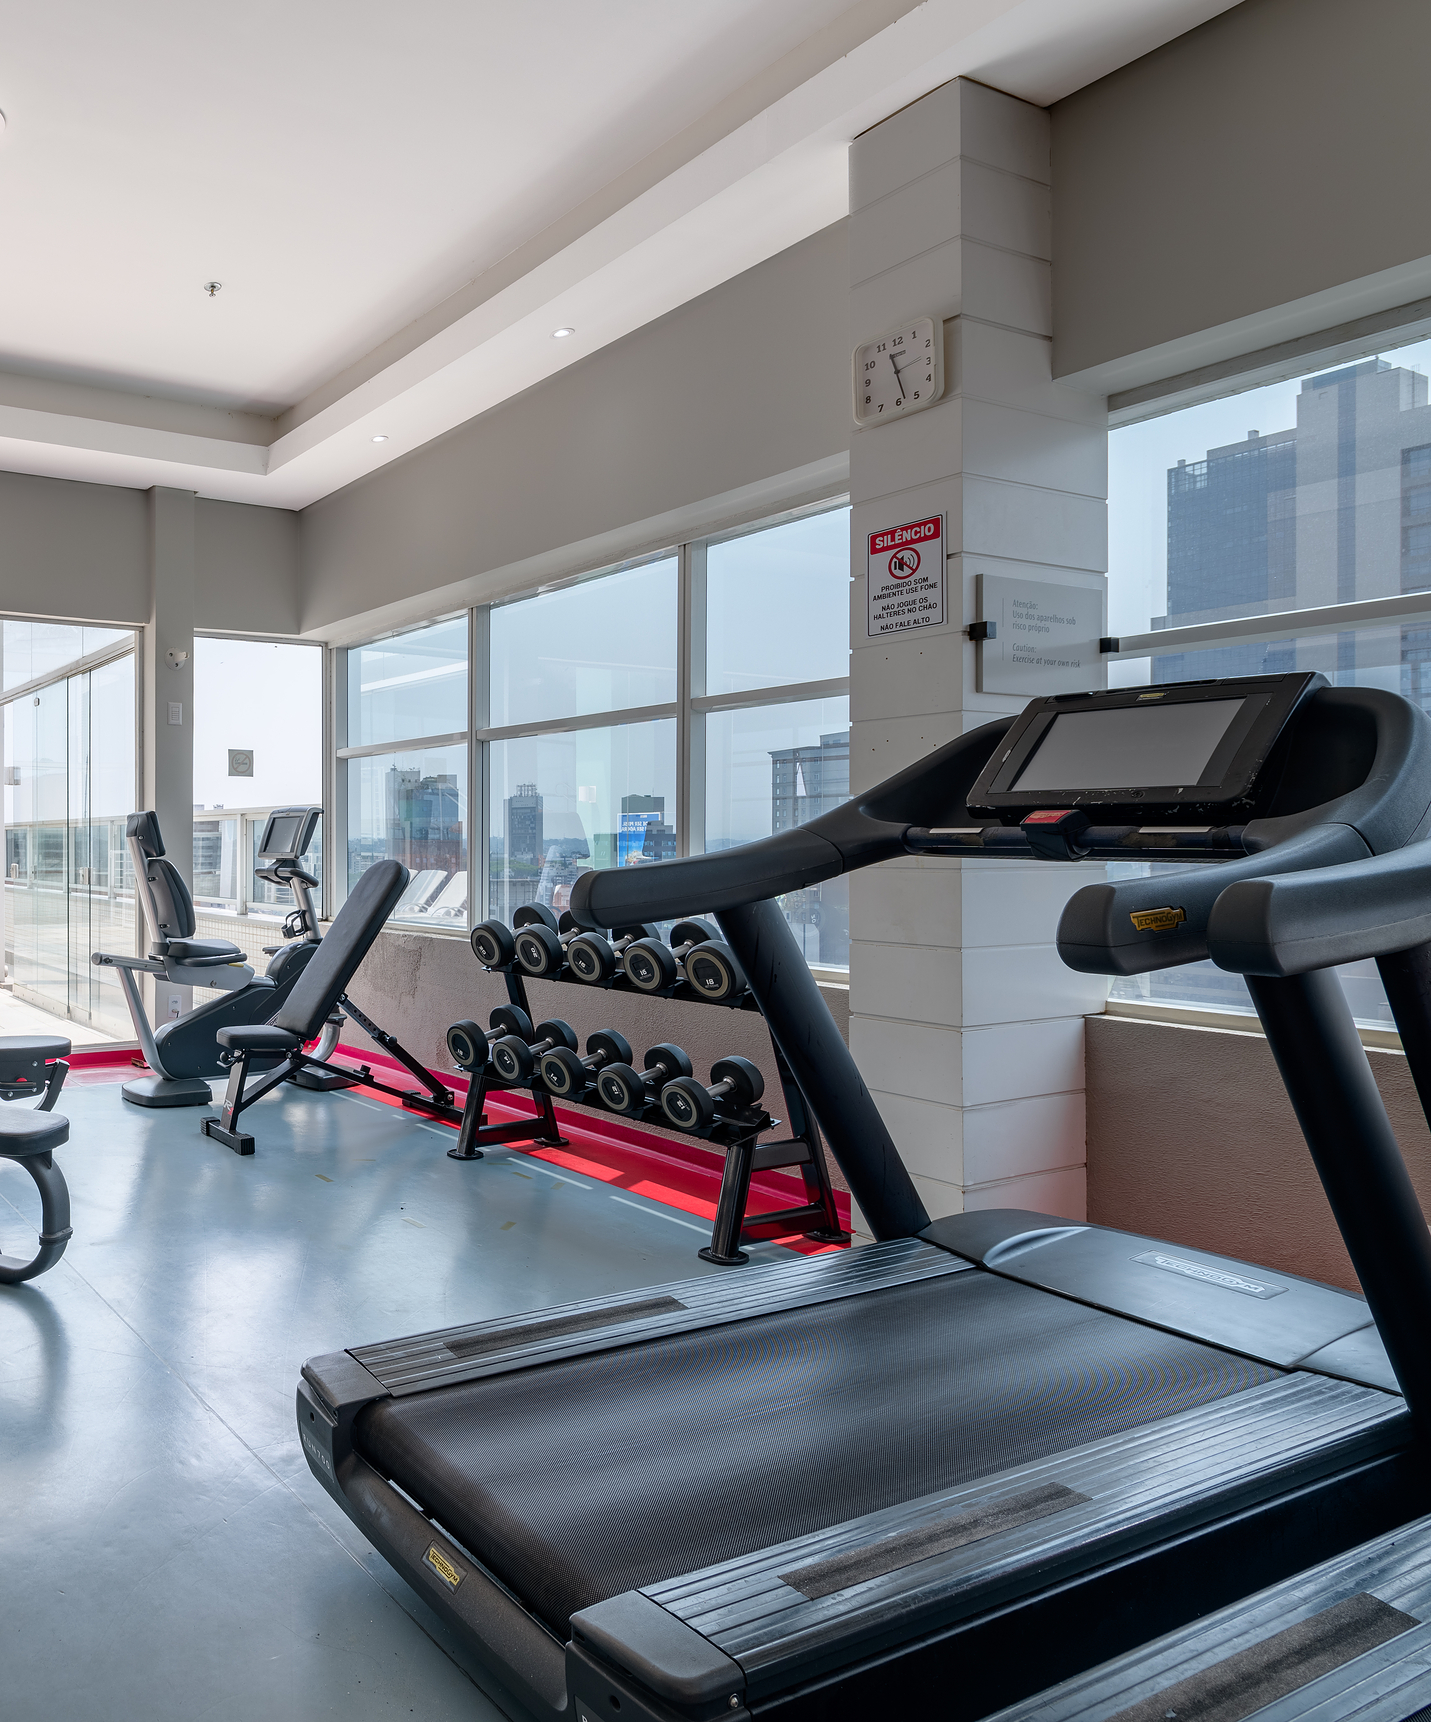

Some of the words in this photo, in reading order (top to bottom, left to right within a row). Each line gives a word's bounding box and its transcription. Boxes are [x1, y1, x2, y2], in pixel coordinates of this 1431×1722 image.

[912, 330, 917, 340] 1
[892, 336, 904, 347] 12
[925, 339, 931, 348] 2
[876, 342, 886, 353] 11
[864, 360, 876, 371] 10
[926, 356, 932, 366] 3
[865, 378, 871, 387] 9
[926, 374, 932, 382] 4
[866, 396, 872, 404] 8
[914, 390, 920, 400] 5
[896, 398, 902, 406] 6
[878, 404, 884, 413] 7
[876, 524, 934, 549] SILÊNCIO
[881, 580, 912, 592] PROIBIDO
[913, 576, 928, 586] SOM
[872, 590, 904, 602] AMBIENTE
[920, 582, 938, 591] FONE
[882, 602, 895, 612] NÃO
[896, 599, 917, 609] JOQUE
[1012, 599, 1038, 610] Atenção:
[874, 609, 906, 620] HALTERES
[918, 602, 938, 611] CHÃO
[1012, 610, 1023, 619] Uso
[1024, 611, 1036, 620] dos
[1036, 614, 1065, 625] aparelhos
[1066, 616, 1076, 625] sob
[880, 622, 894, 631] NÃO
[895, 619, 911, 628] FALE
[912, 616, 930, 625] ALTO
[1012, 622, 1026, 631] risco
[1028, 624, 1050, 634] próprio
[1012, 642, 1037, 653] Caution:
[1012, 654, 1035, 664] Exercise
[1043, 657, 1056, 667] your
[1070, 659, 1081, 668] risk
[1132, 912, 1182, 928] TECHNOGYM
